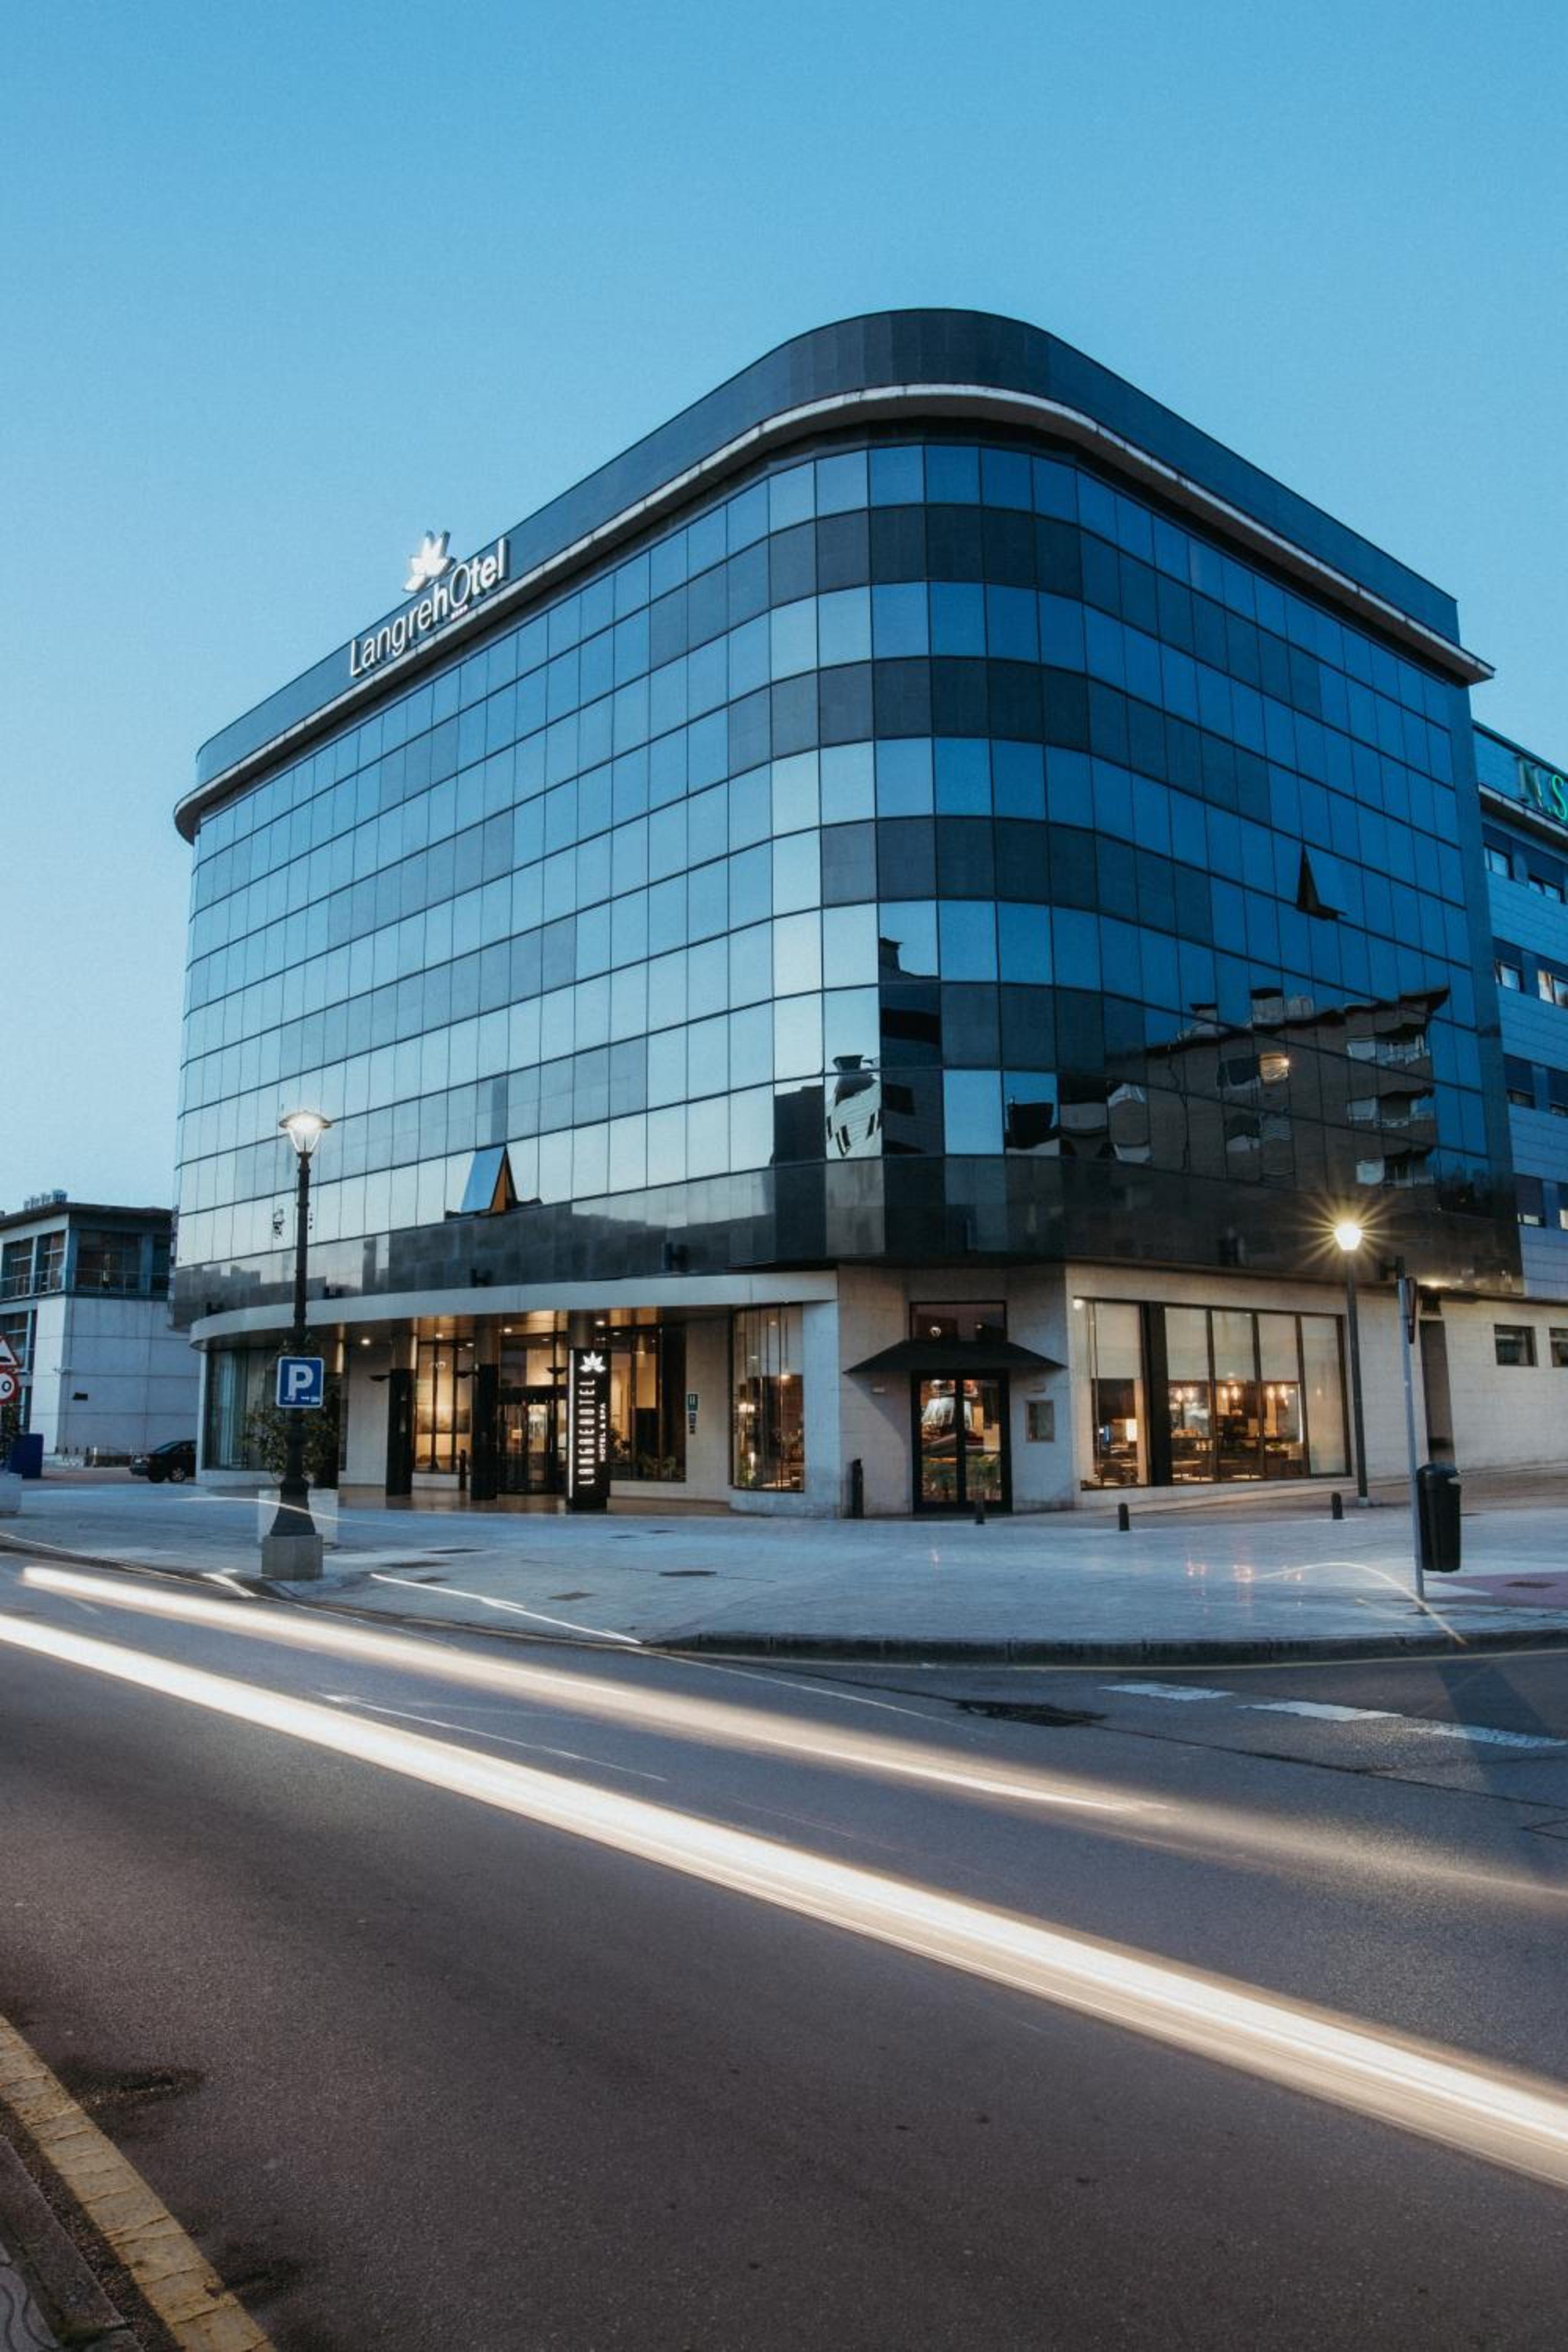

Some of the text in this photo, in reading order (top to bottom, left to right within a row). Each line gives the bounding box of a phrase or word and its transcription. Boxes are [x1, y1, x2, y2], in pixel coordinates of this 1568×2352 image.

[350, 538, 508, 677] LangrehOtel
[289, 1364, 314, 1402] P
[578, 1379, 595, 1484] LANGREHOTEL
